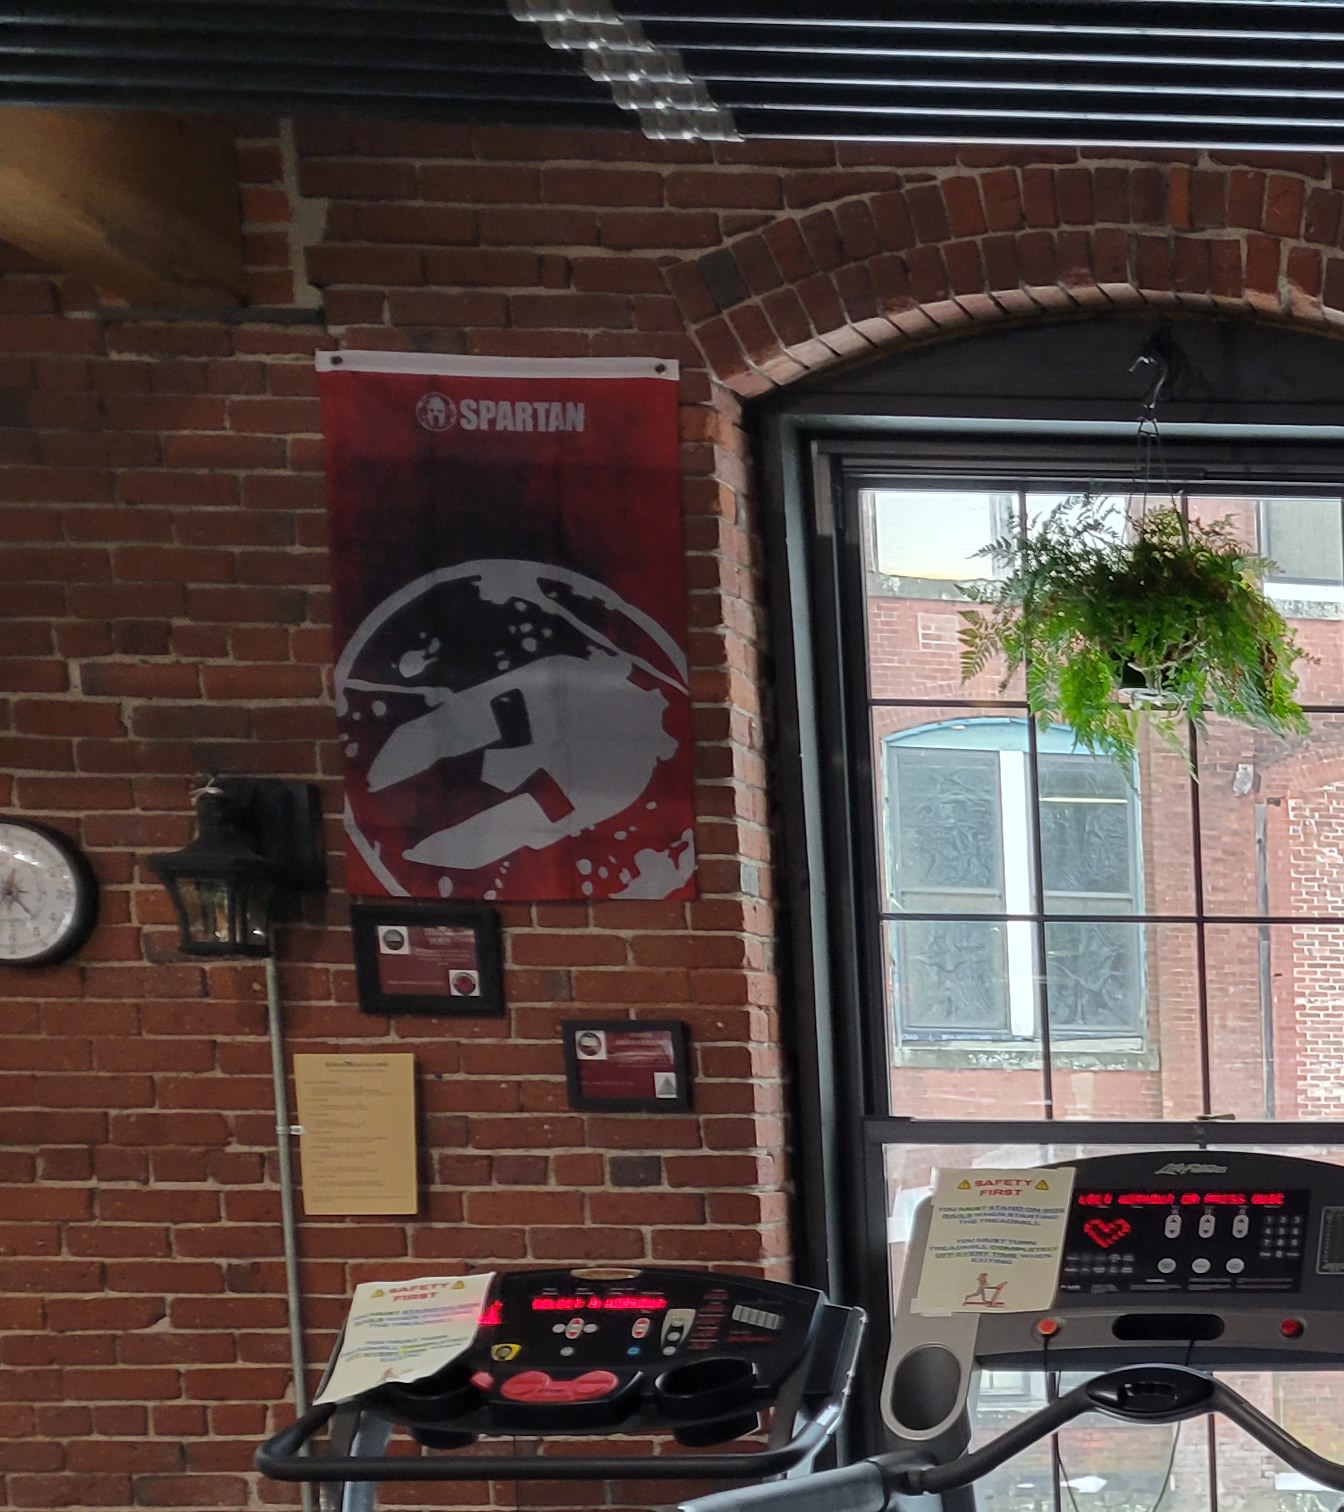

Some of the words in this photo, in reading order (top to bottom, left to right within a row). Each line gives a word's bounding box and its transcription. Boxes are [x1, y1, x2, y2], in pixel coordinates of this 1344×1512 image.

[459, 398, 585, 432] SPARTAN
[974, 1178, 1033, 1187] SAFETY
[979, 1188, 1023, 1196] FIRST
[389, 1282, 450, 1293] SAFETY
[393, 1292, 437, 1302] FIRST
